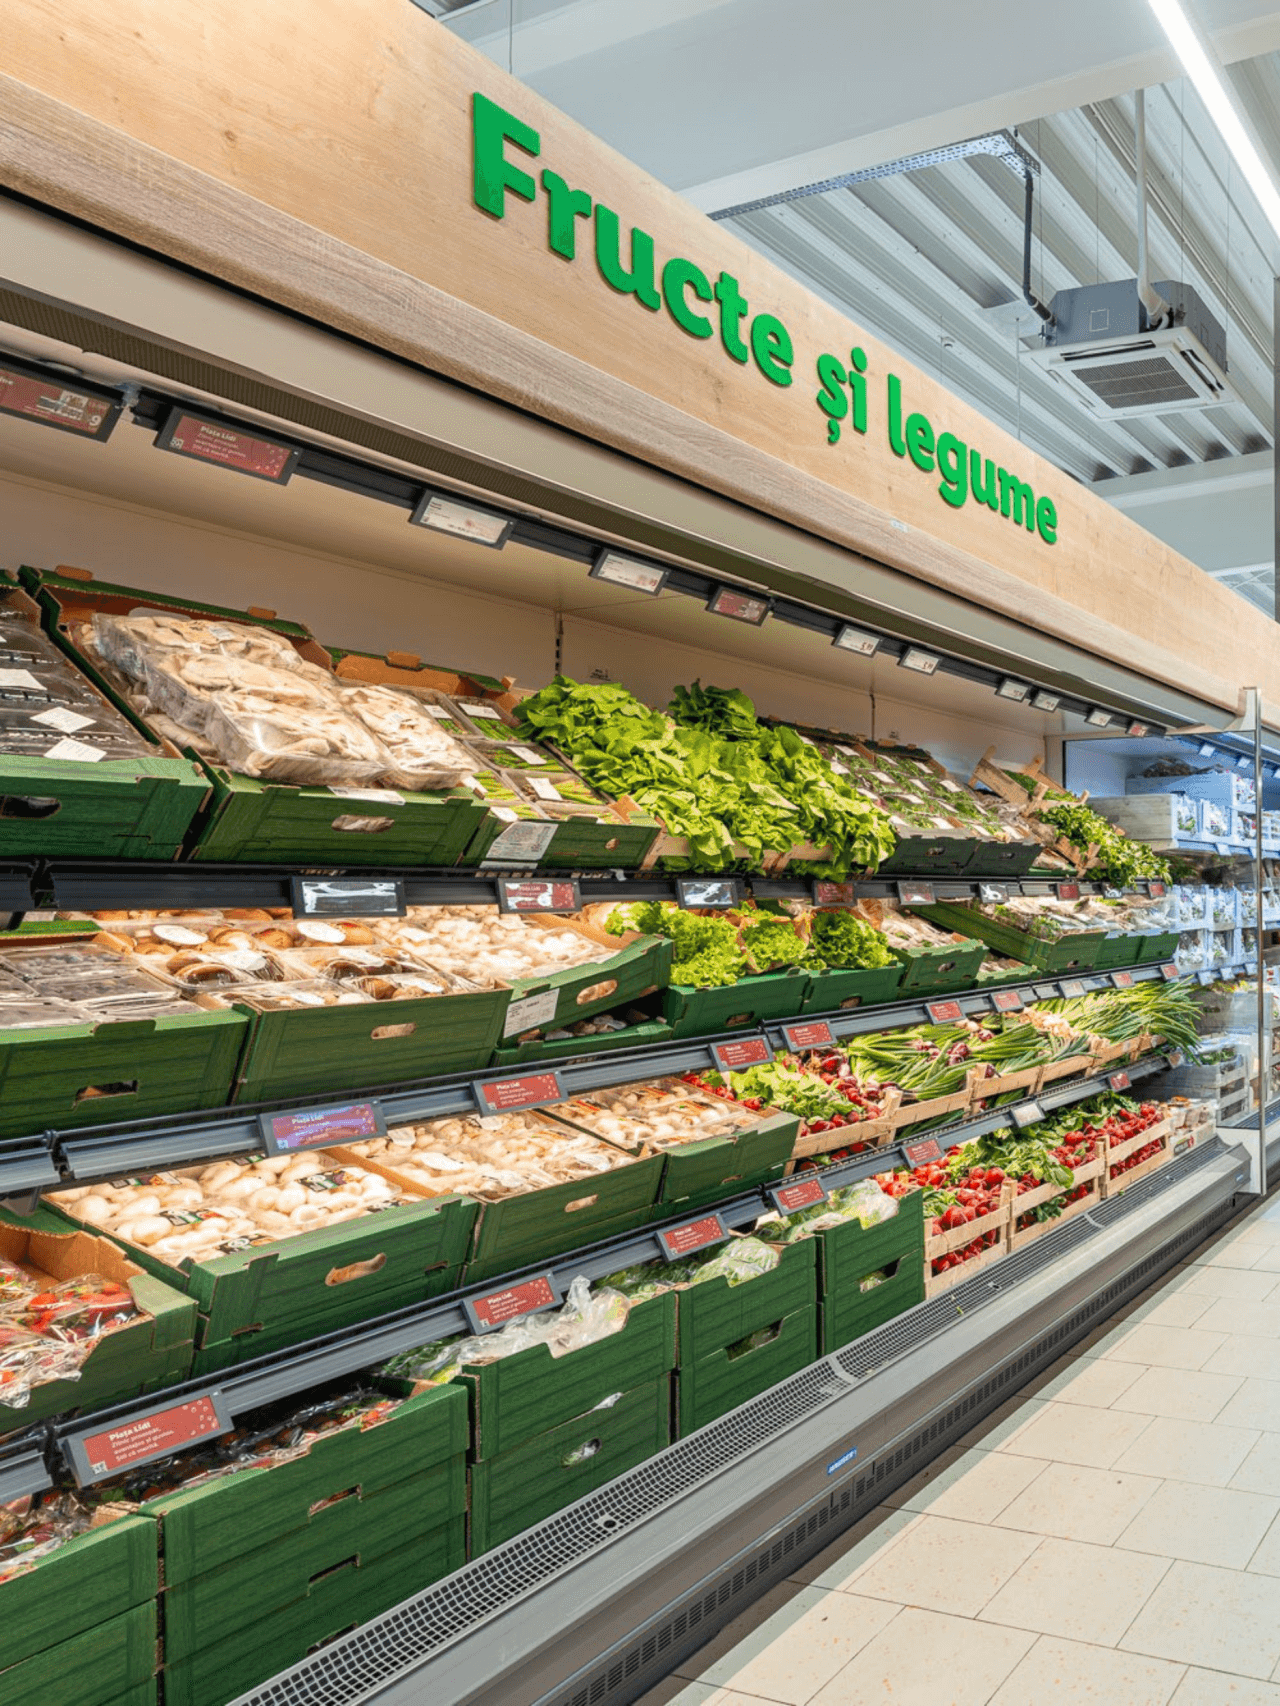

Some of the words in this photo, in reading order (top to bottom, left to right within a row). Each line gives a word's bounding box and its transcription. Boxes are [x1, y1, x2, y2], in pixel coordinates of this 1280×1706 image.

[473, 92, 794, 387] Fructe
[816, 347, 868, 443] și
[887, 373, 1058, 544] legume
[133, 1421, 151, 1433] Lidl
